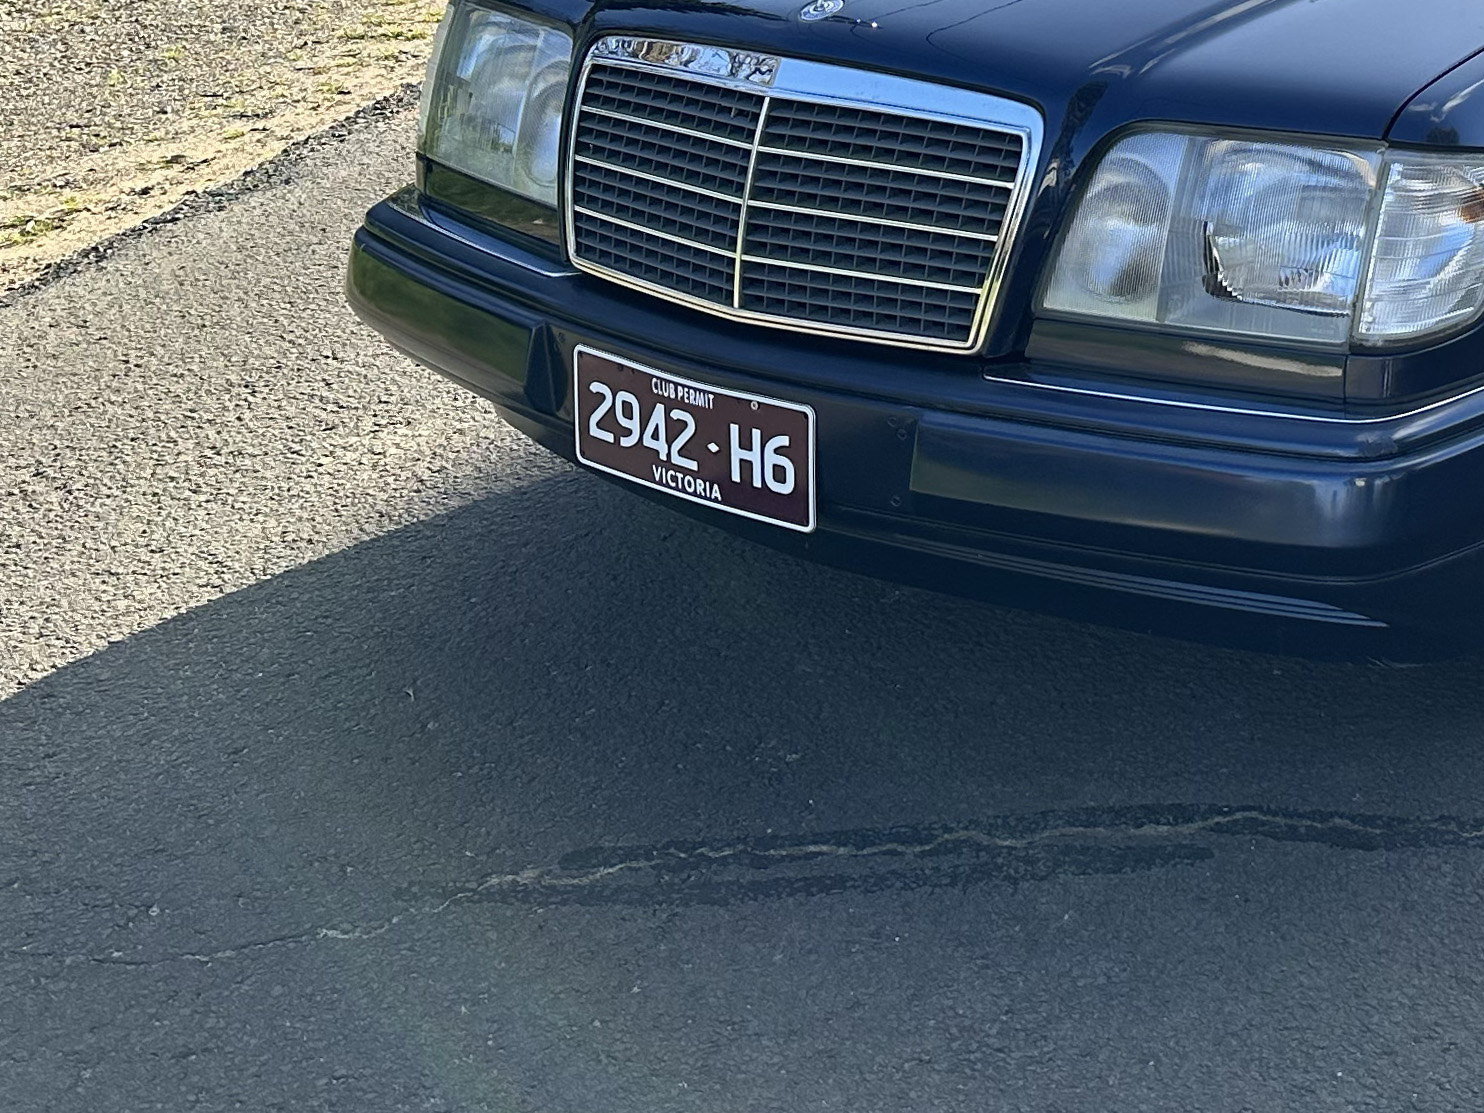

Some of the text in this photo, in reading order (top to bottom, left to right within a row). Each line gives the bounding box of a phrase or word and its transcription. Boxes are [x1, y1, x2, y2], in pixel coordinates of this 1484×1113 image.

[651, 377, 714, 409] CLUB PERMIT
[652, 464, 722, 501] VICTORIA
